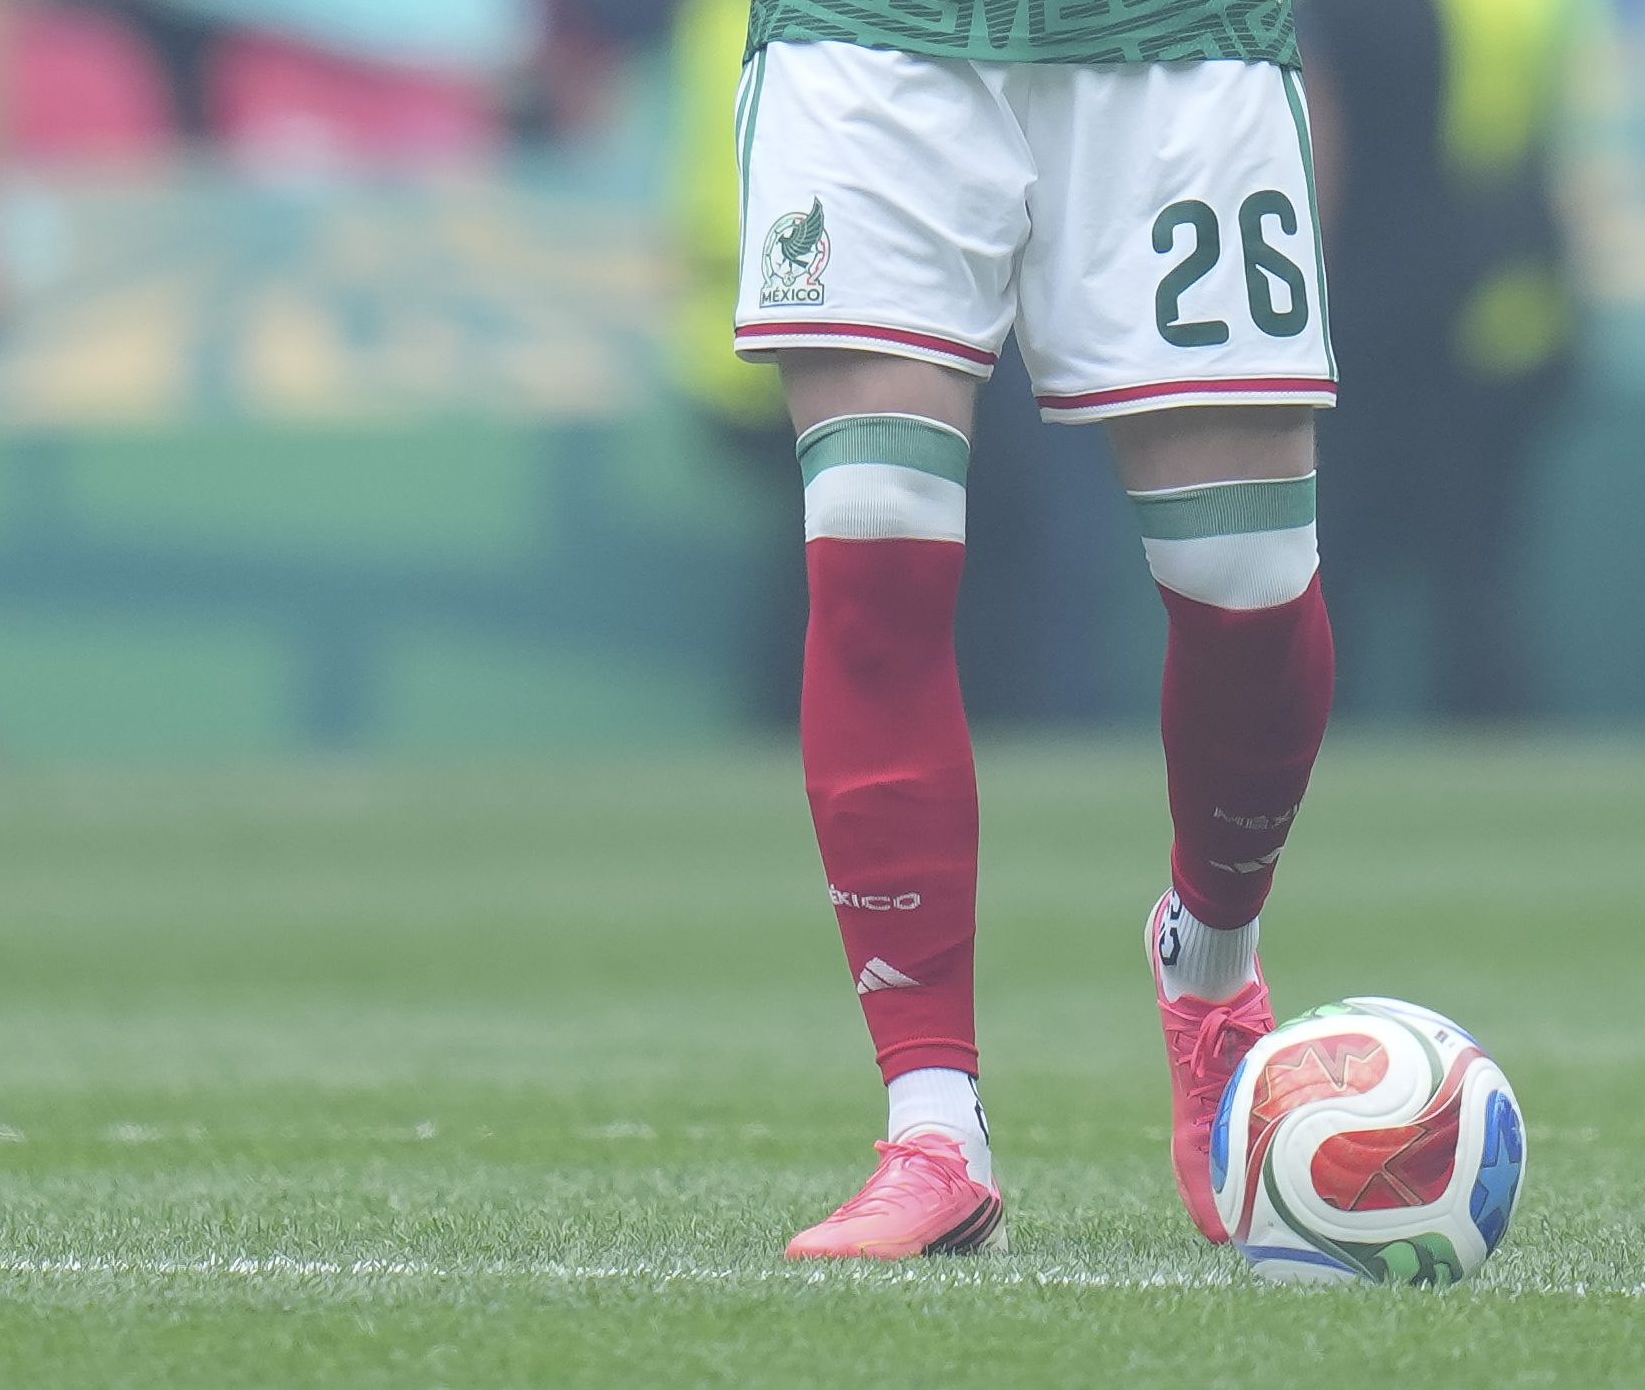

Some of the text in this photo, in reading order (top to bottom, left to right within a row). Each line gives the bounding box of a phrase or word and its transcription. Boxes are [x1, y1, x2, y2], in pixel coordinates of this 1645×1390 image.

[1152, 189, 1309, 347] 26
[761, 286, 821, 305] MÉXICO
[828, 883, 921, 911] ÉXICO
